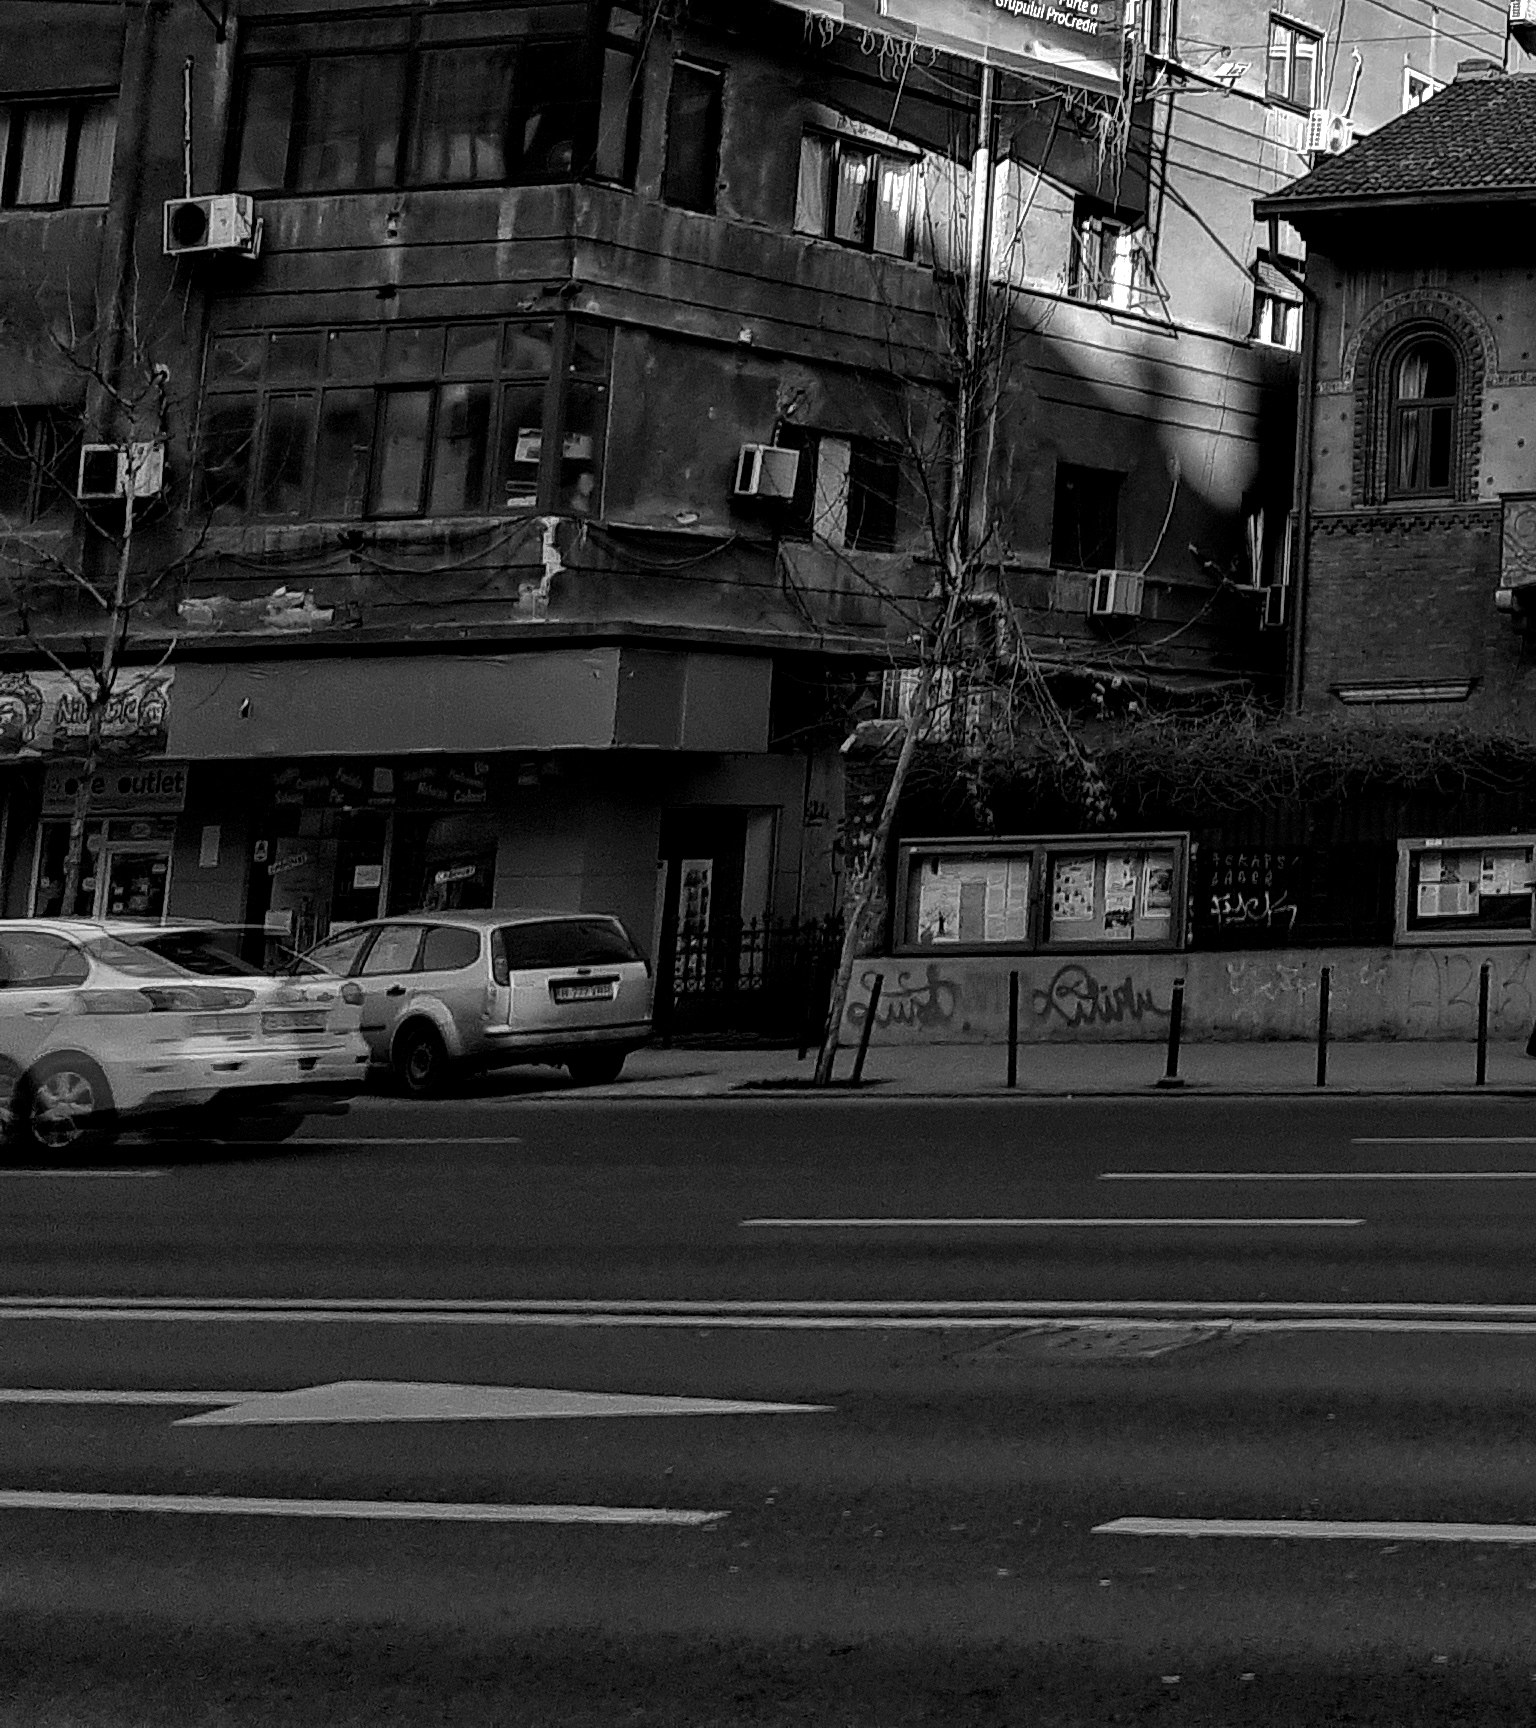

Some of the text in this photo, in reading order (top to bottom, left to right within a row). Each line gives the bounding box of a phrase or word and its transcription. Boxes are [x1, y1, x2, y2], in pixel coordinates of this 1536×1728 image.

[1046, 5, 1099, 36] ProCredit
[1090, 2, 1099, 16] a
[117, 769, 184, 794] outlet
